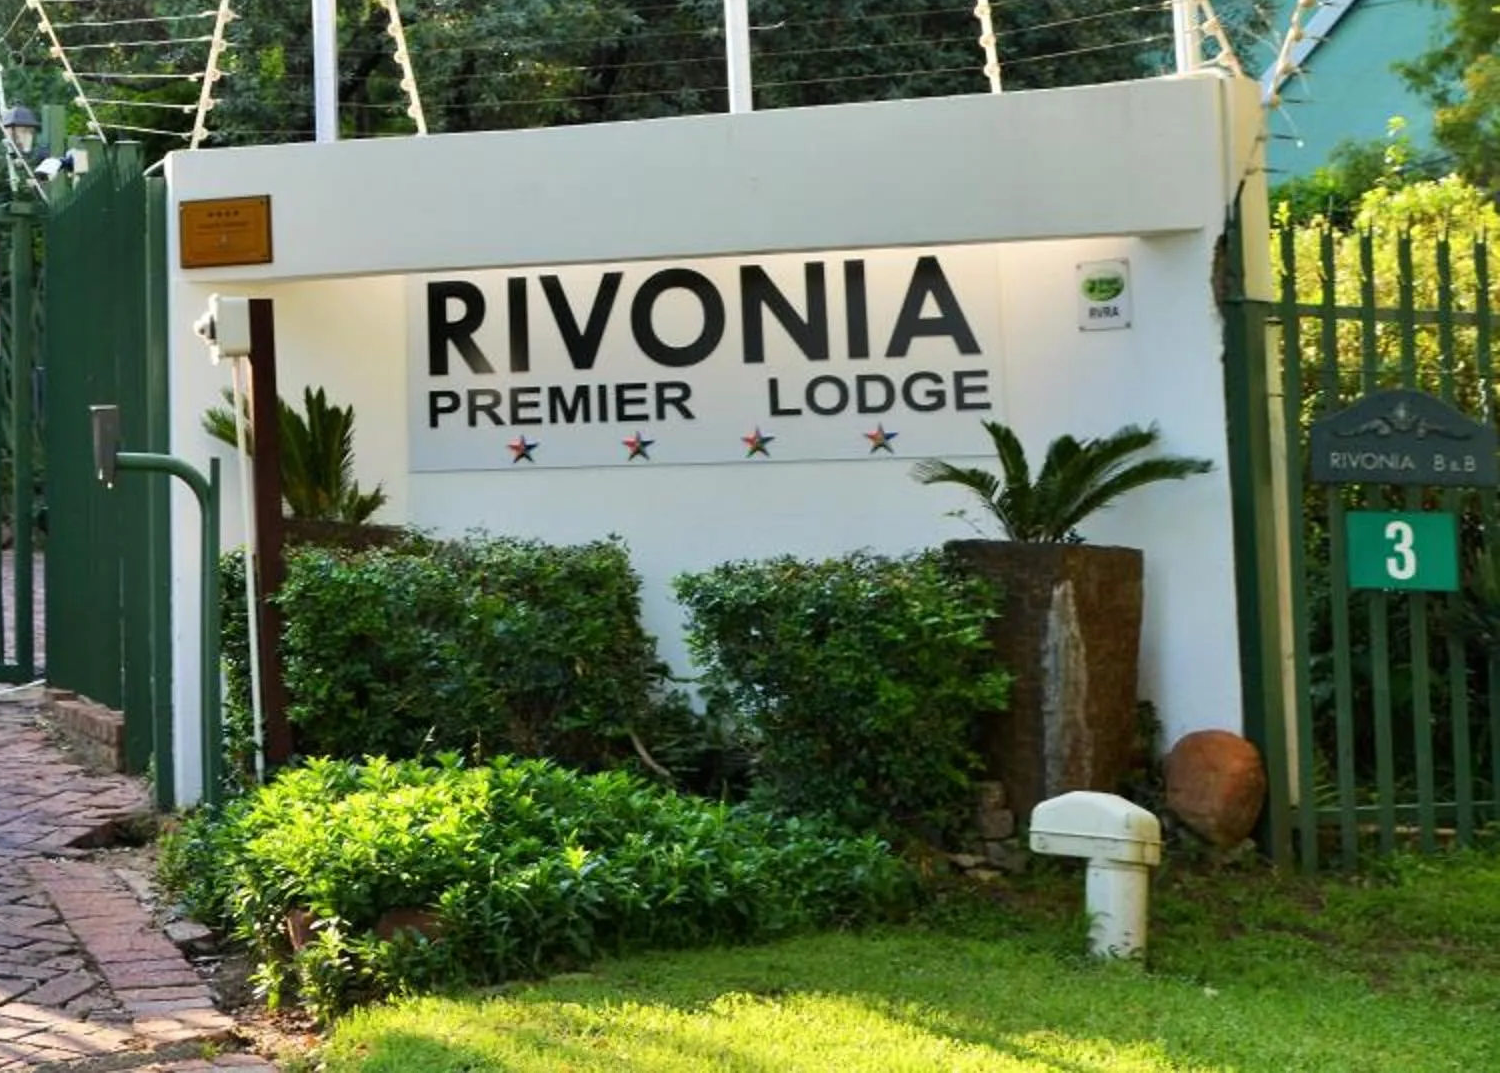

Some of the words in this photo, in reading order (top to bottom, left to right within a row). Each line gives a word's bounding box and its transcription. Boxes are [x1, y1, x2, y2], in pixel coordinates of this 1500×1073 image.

[426, 255, 982, 377] RIVONIA
[429, 381, 696, 428] PREMIER
[768, 370, 992, 417] LODGE
[1330, 452, 1416, 470] RIVONIA
[1384, 521, 1417, 580] 3
